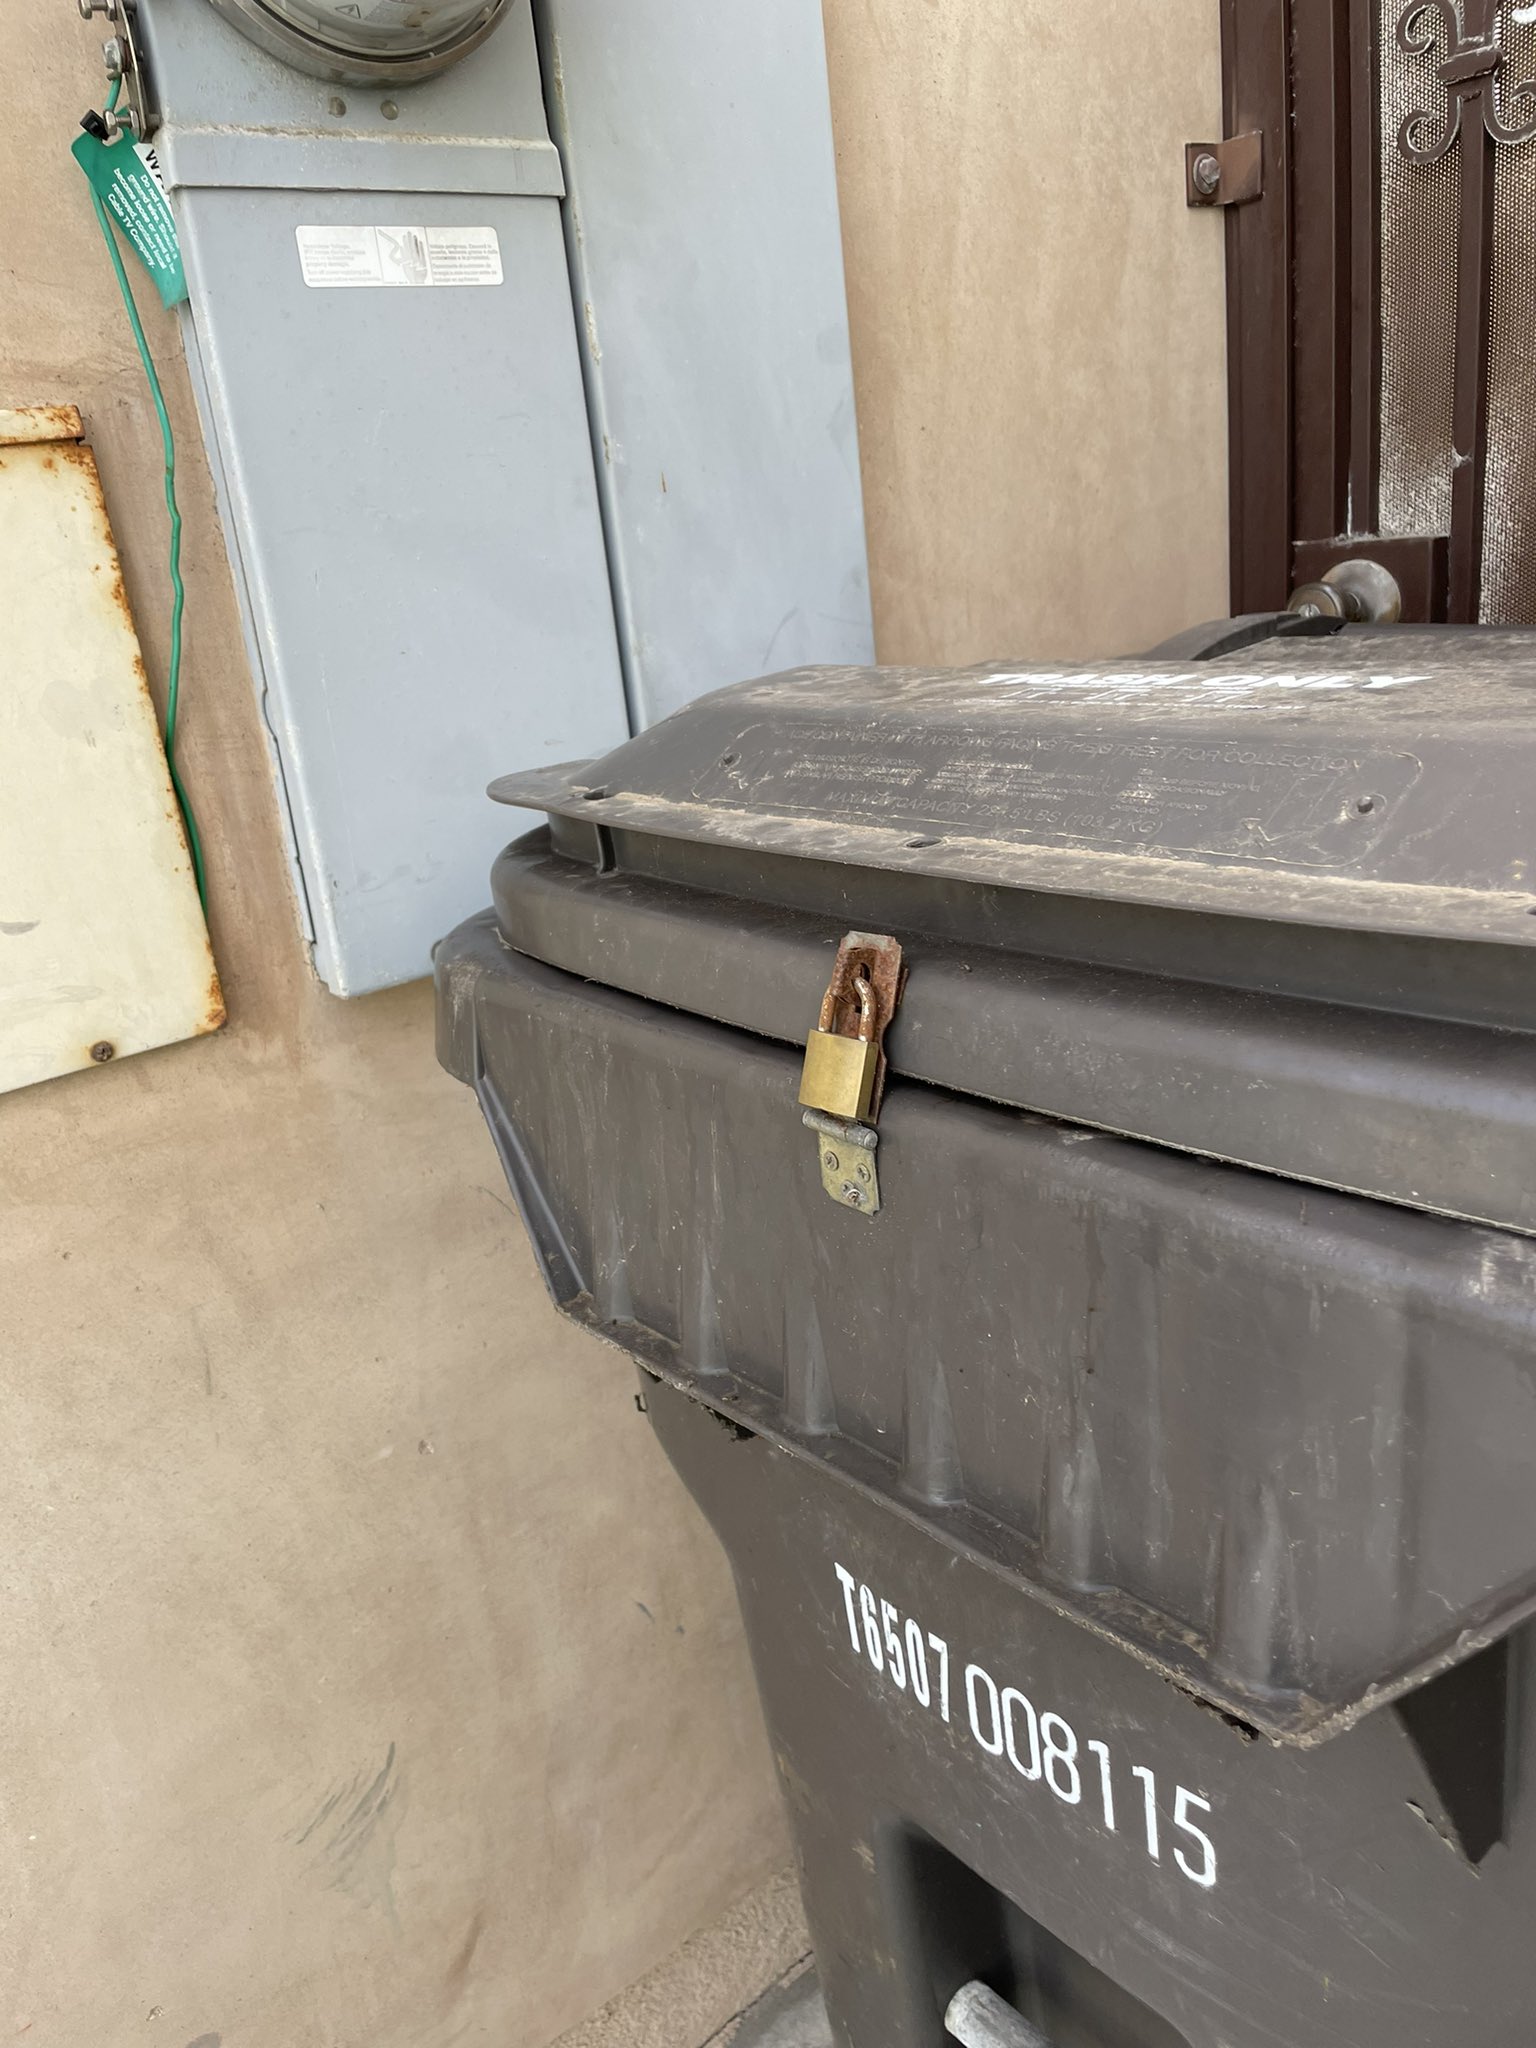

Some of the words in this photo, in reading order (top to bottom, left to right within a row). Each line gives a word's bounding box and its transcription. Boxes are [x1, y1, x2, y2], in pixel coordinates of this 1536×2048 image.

[108, 193, 124, 217] Cable
[122, 215, 134, 228] TV
[130, 228, 155, 268] Company.
[111, 183, 138, 220] removed,
[135, 220, 156, 249] contact
[153, 250, 167, 269] local
[114, 168, 136, 201] become
[134, 200, 151, 223] loose
[148, 223, 157, 233] or
[154, 233, 168, 254] need
[165, 253, 171, 263] to
[127, 174, 150, 204] ground
[147, 203, 160, 224] wire.
[159, 223, 175, 252] Should
[141, 174, 150, 188] Do
[148, 188, 160, 203] not
[157, 203, 174, 233] remove
[978, 673, 1198, 685] TRASH
[1200, 674, 1433, 688] ONLY
[1175, 746, 1221, 762] FOR
[1223, 749, 1368, 772] COLLECTION
[834, 1562, 950, 1723] T6507
[965, 1664, 1217, 1888] 008115
